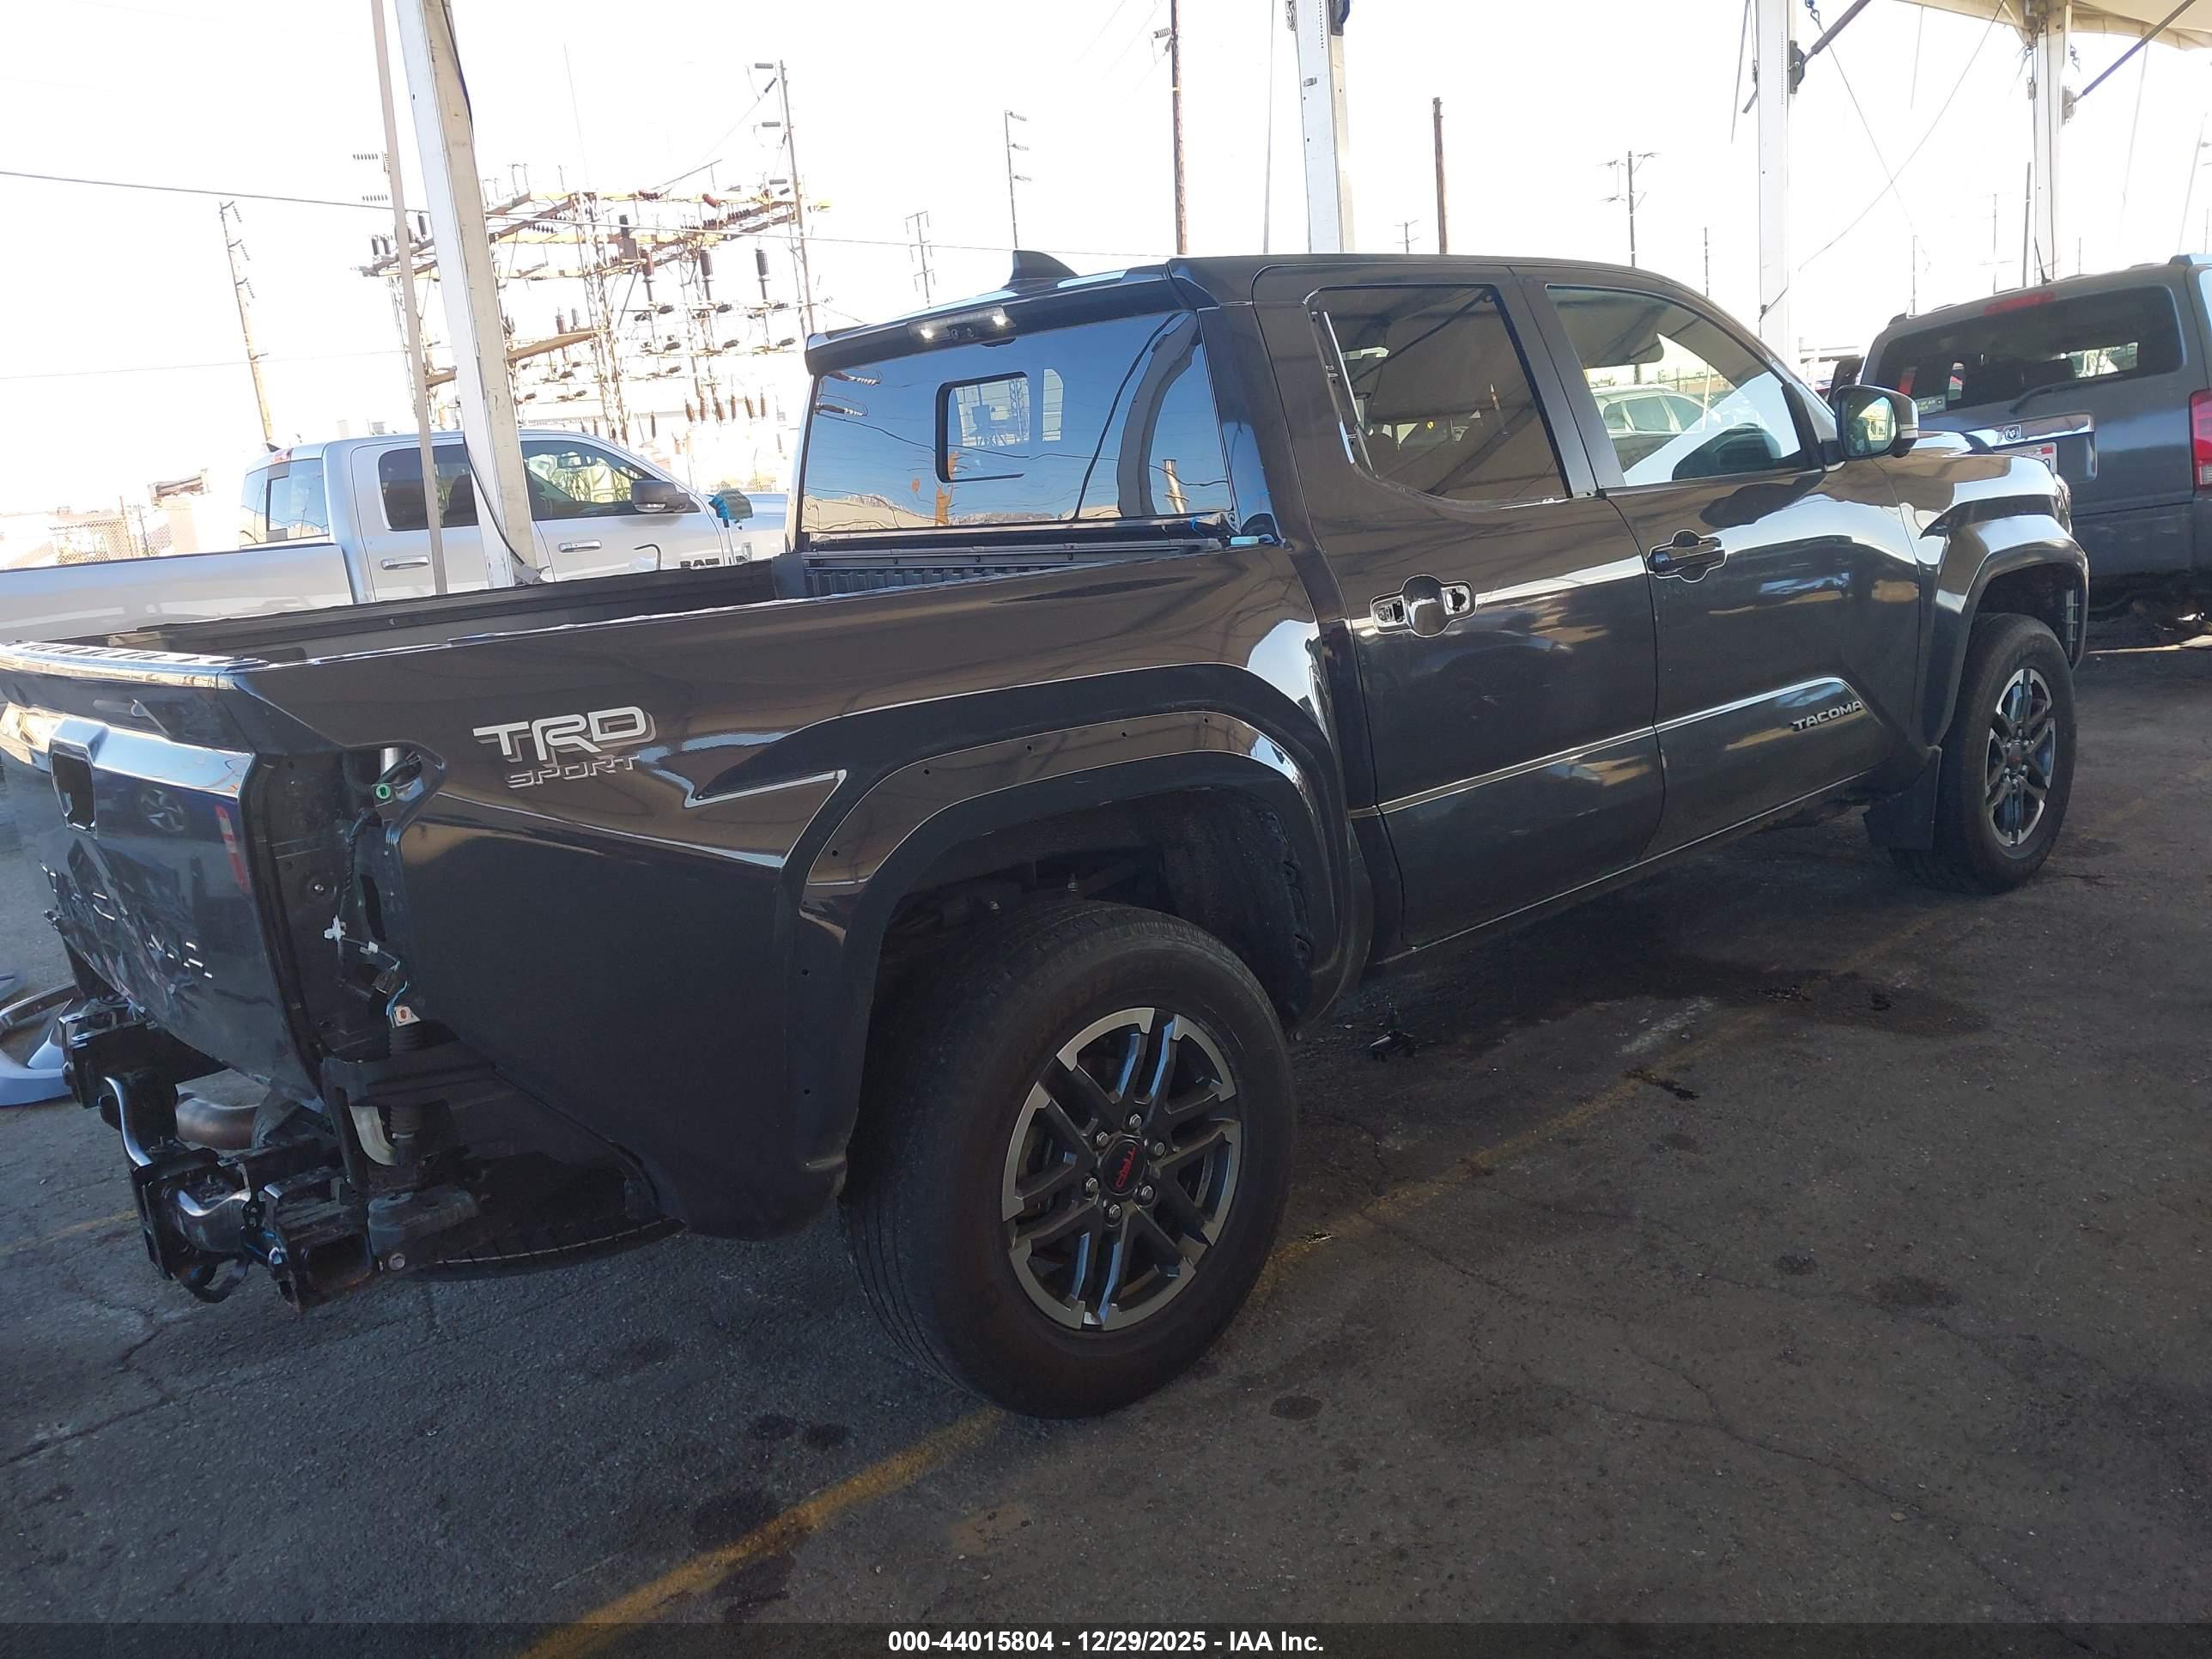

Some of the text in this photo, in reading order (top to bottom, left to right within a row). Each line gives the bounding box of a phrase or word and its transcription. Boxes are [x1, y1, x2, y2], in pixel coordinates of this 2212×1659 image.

[472, 706, 646, 761] TRD
[1792, 701, 1863, 730] TACOMA
[507, 754, 640, 788] SPORT
[1115, 1146, 1138, 1188] TRD
